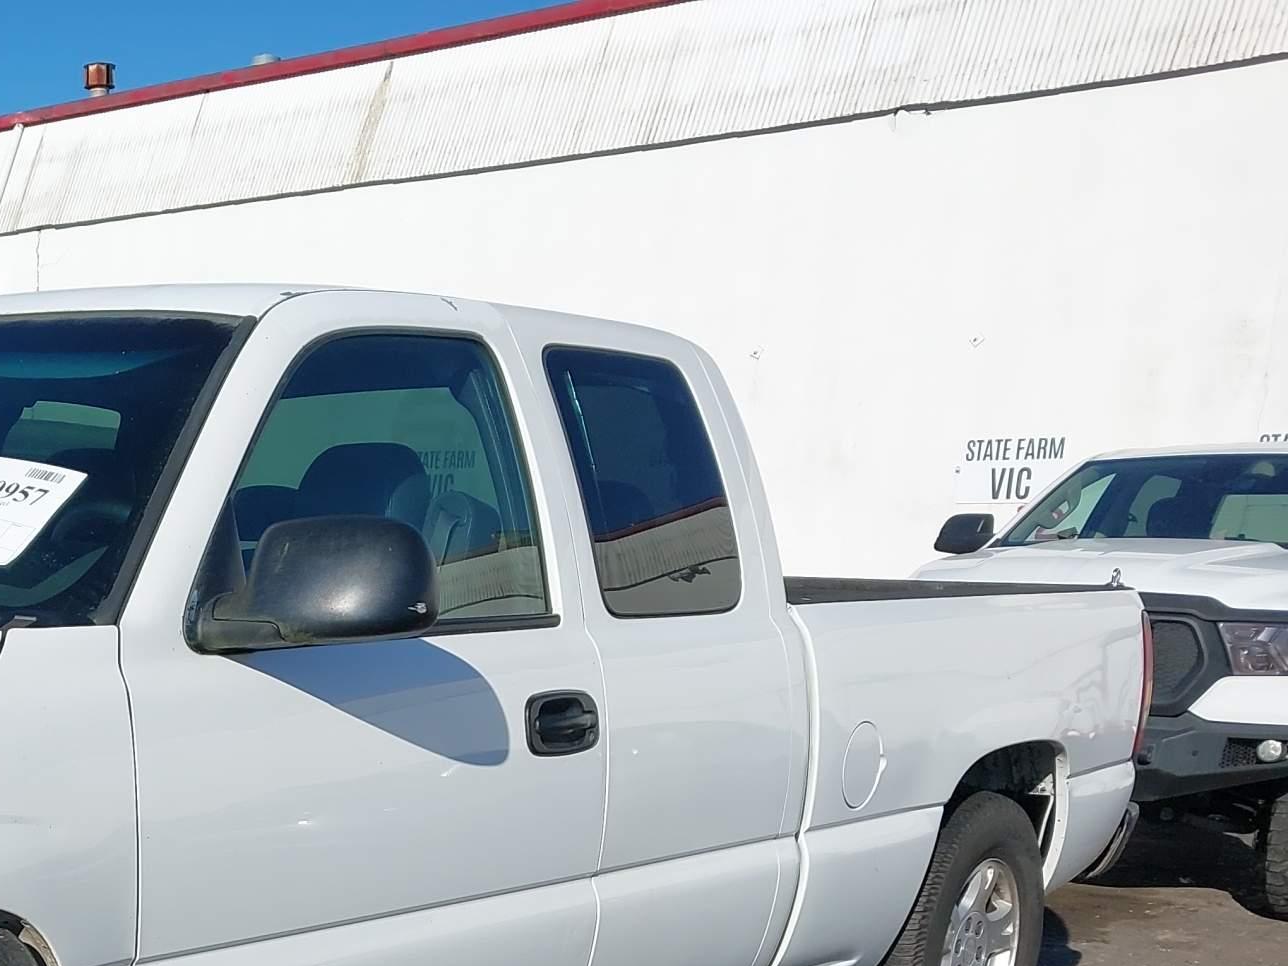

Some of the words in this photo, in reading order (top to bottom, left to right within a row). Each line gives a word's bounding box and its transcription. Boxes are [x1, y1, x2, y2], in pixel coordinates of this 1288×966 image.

[417, 450, 441, 469] TATE
[443, 450, 476, 469] FARM
[965, 438, 1012, 461] STATE
[1015, 437, 1066, 460] FARM
[991, 466, 1032, 500] VIC
